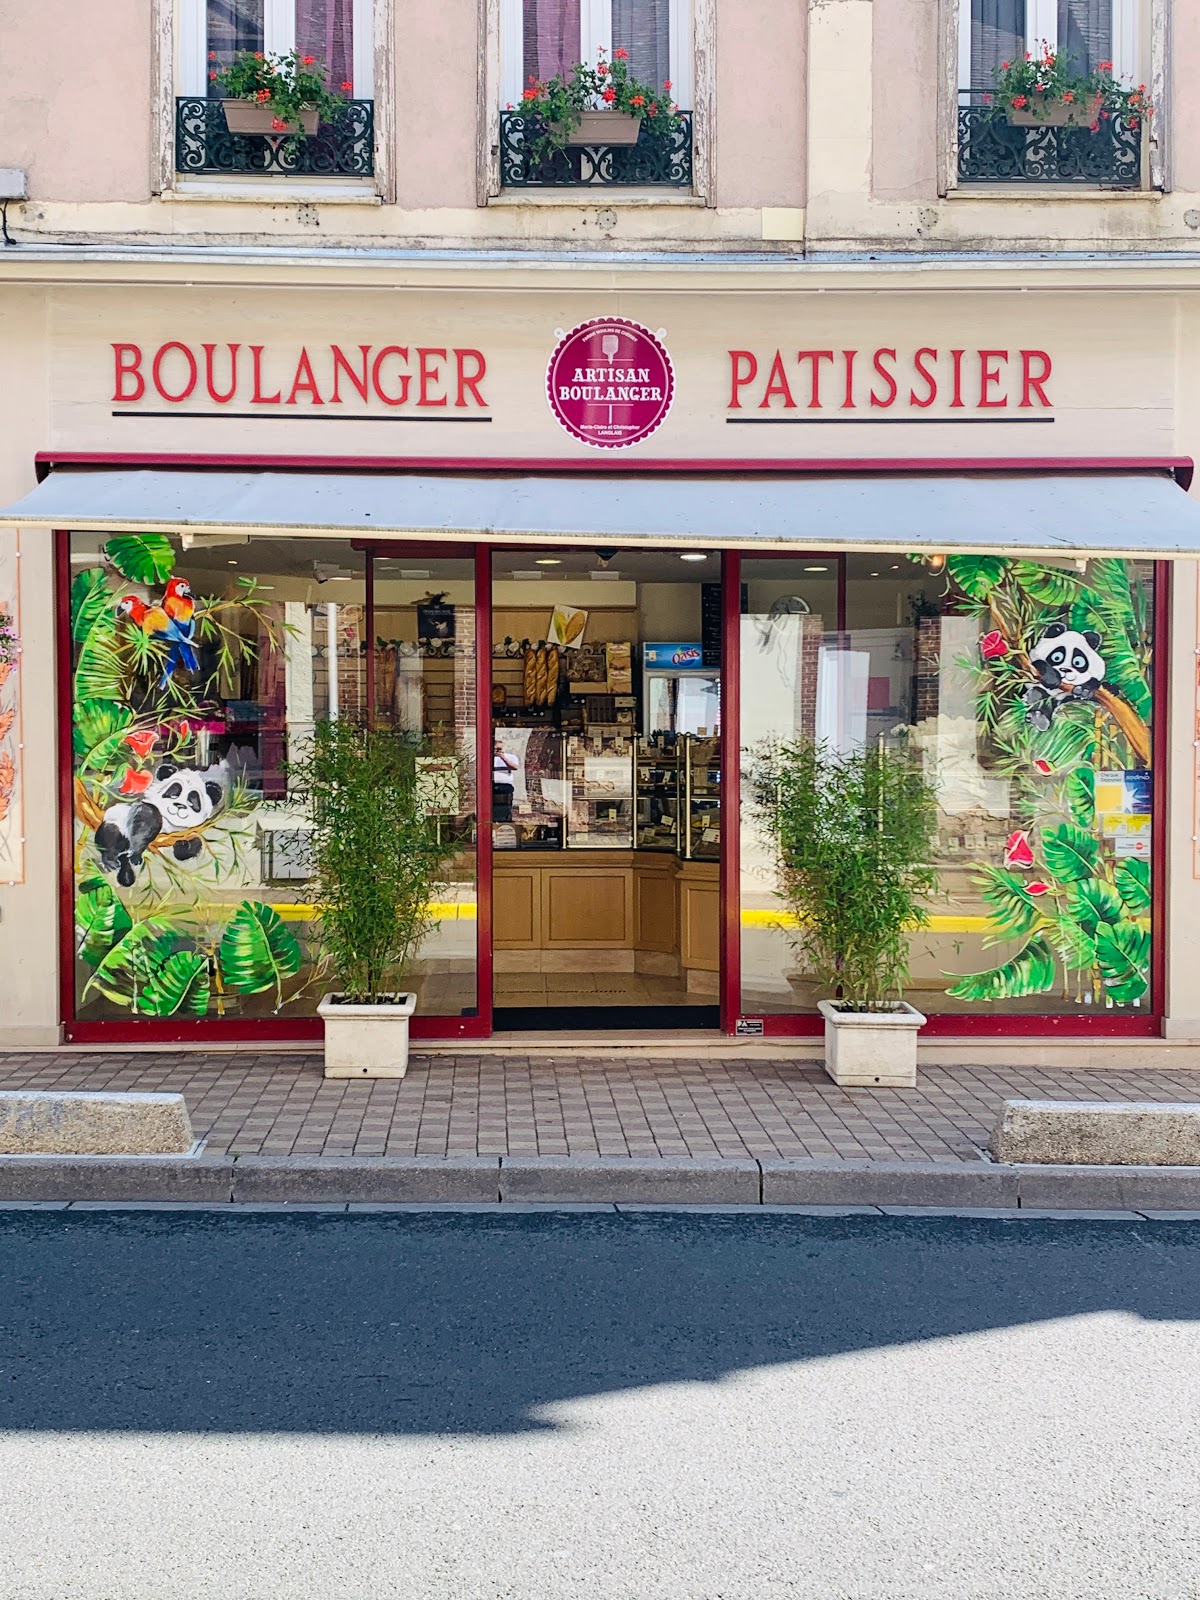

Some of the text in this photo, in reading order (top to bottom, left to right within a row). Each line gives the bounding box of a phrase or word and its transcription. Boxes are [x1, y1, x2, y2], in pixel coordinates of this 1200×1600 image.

[111, 341, 488, 408] BOULANGER
[571, 367, 650, 383] ARTISAN
[727, 346, 1053, 409] PATISSIER
[559, 386, 662, 401] BOULANGER
[671, 647, 701, 666] Oasis
